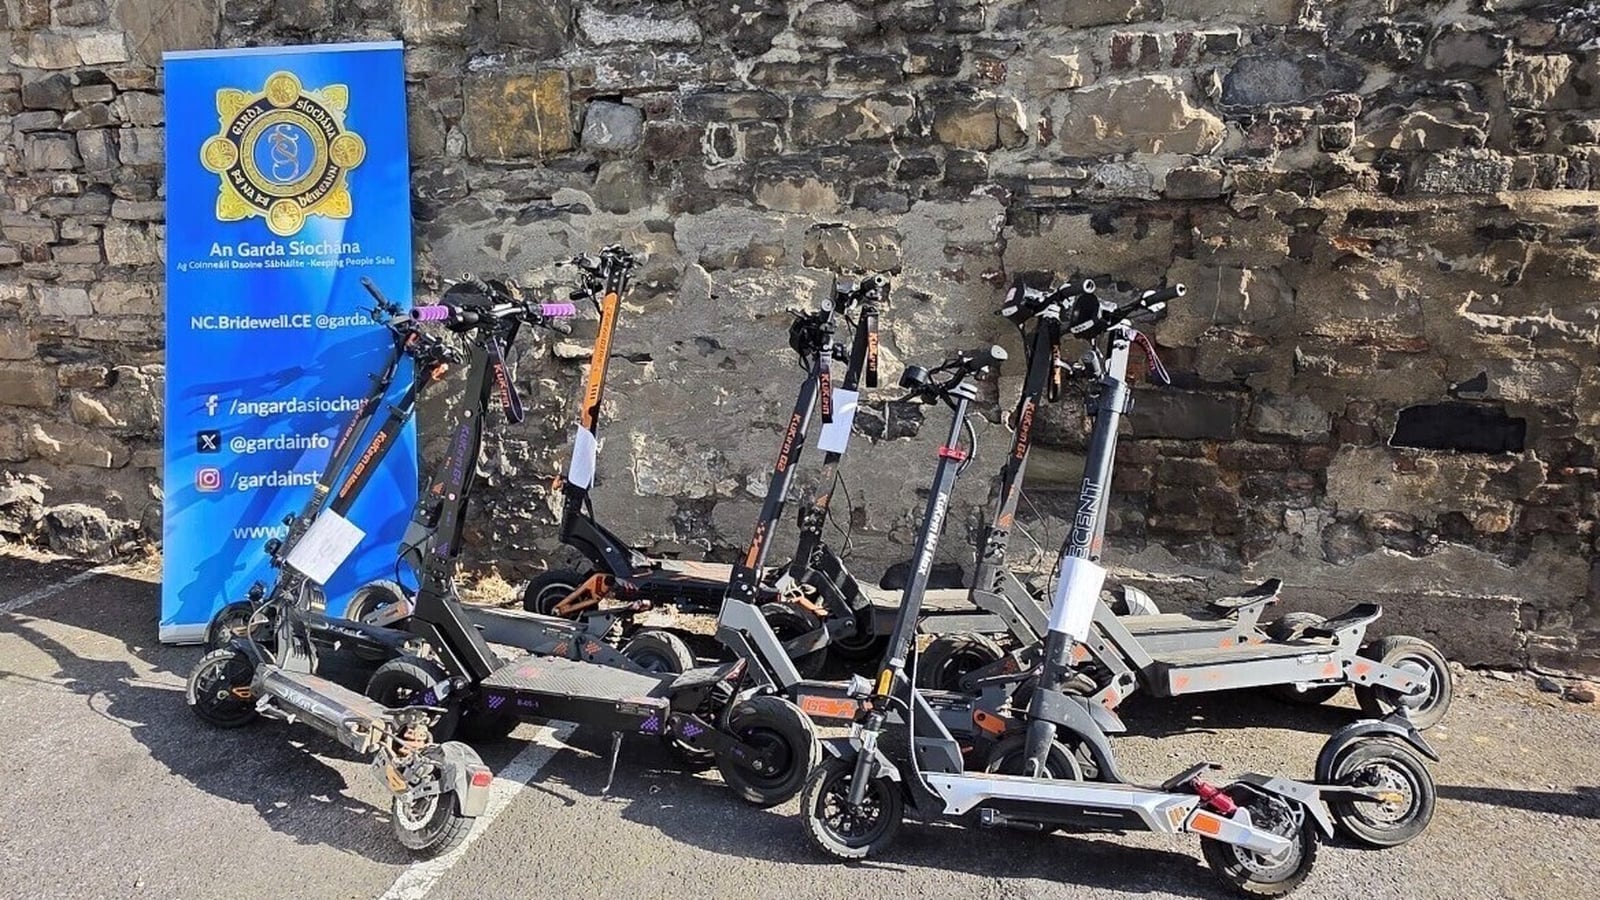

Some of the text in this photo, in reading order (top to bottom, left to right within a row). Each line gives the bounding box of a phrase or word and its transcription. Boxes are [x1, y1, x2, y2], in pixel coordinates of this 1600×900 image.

[210, 240, 360, 257] An Garda Síochána
[177, 262, 187, 271] Ag
[189, 260, 229, 269] Coinneáil
[231, 260, 262, 269] Daoine
[345, 257, 374, 268] People
[375, 256, 395, 266] Safe
[191, 314, 312, 331] NC.Bridewell.CE
[230, 433, 329, 454] @gardainfo
[230, 470, 323, 491] /gardainst
[233, 525, 290, 540] www.
